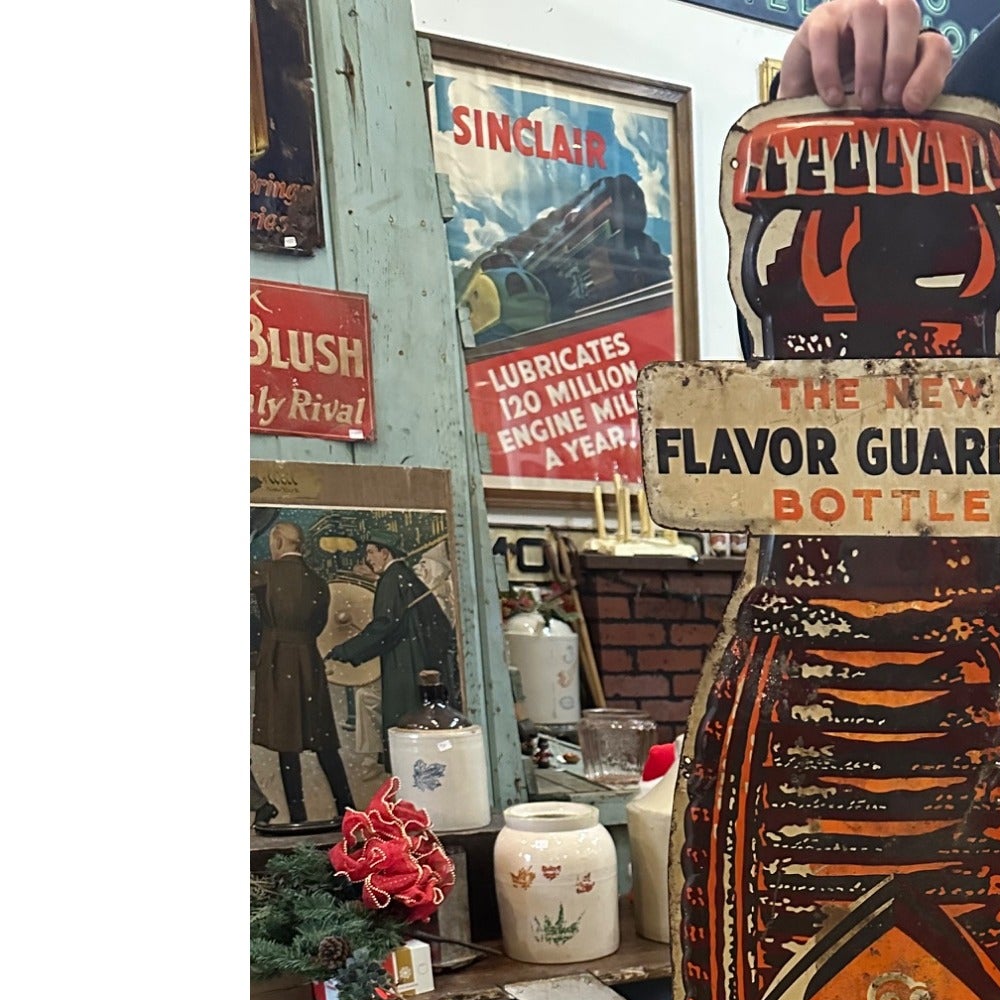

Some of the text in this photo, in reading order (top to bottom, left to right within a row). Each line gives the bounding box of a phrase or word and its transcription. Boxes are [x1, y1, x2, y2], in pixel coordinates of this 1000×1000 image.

[452, 105, 607, 170] SINCLAIR
[288, 387, 366, 425] Rival
[499, 360, 638, 421] 120 MILLION
[771, 378, 986, 410] THE NEW
[497, 407, 587, 454] ENGINE
[545, 418, 638, 471] A YEAR!
[655, 428, 838, 475] FLAVOR
[772, 488, 990, 521] BOTTLE
